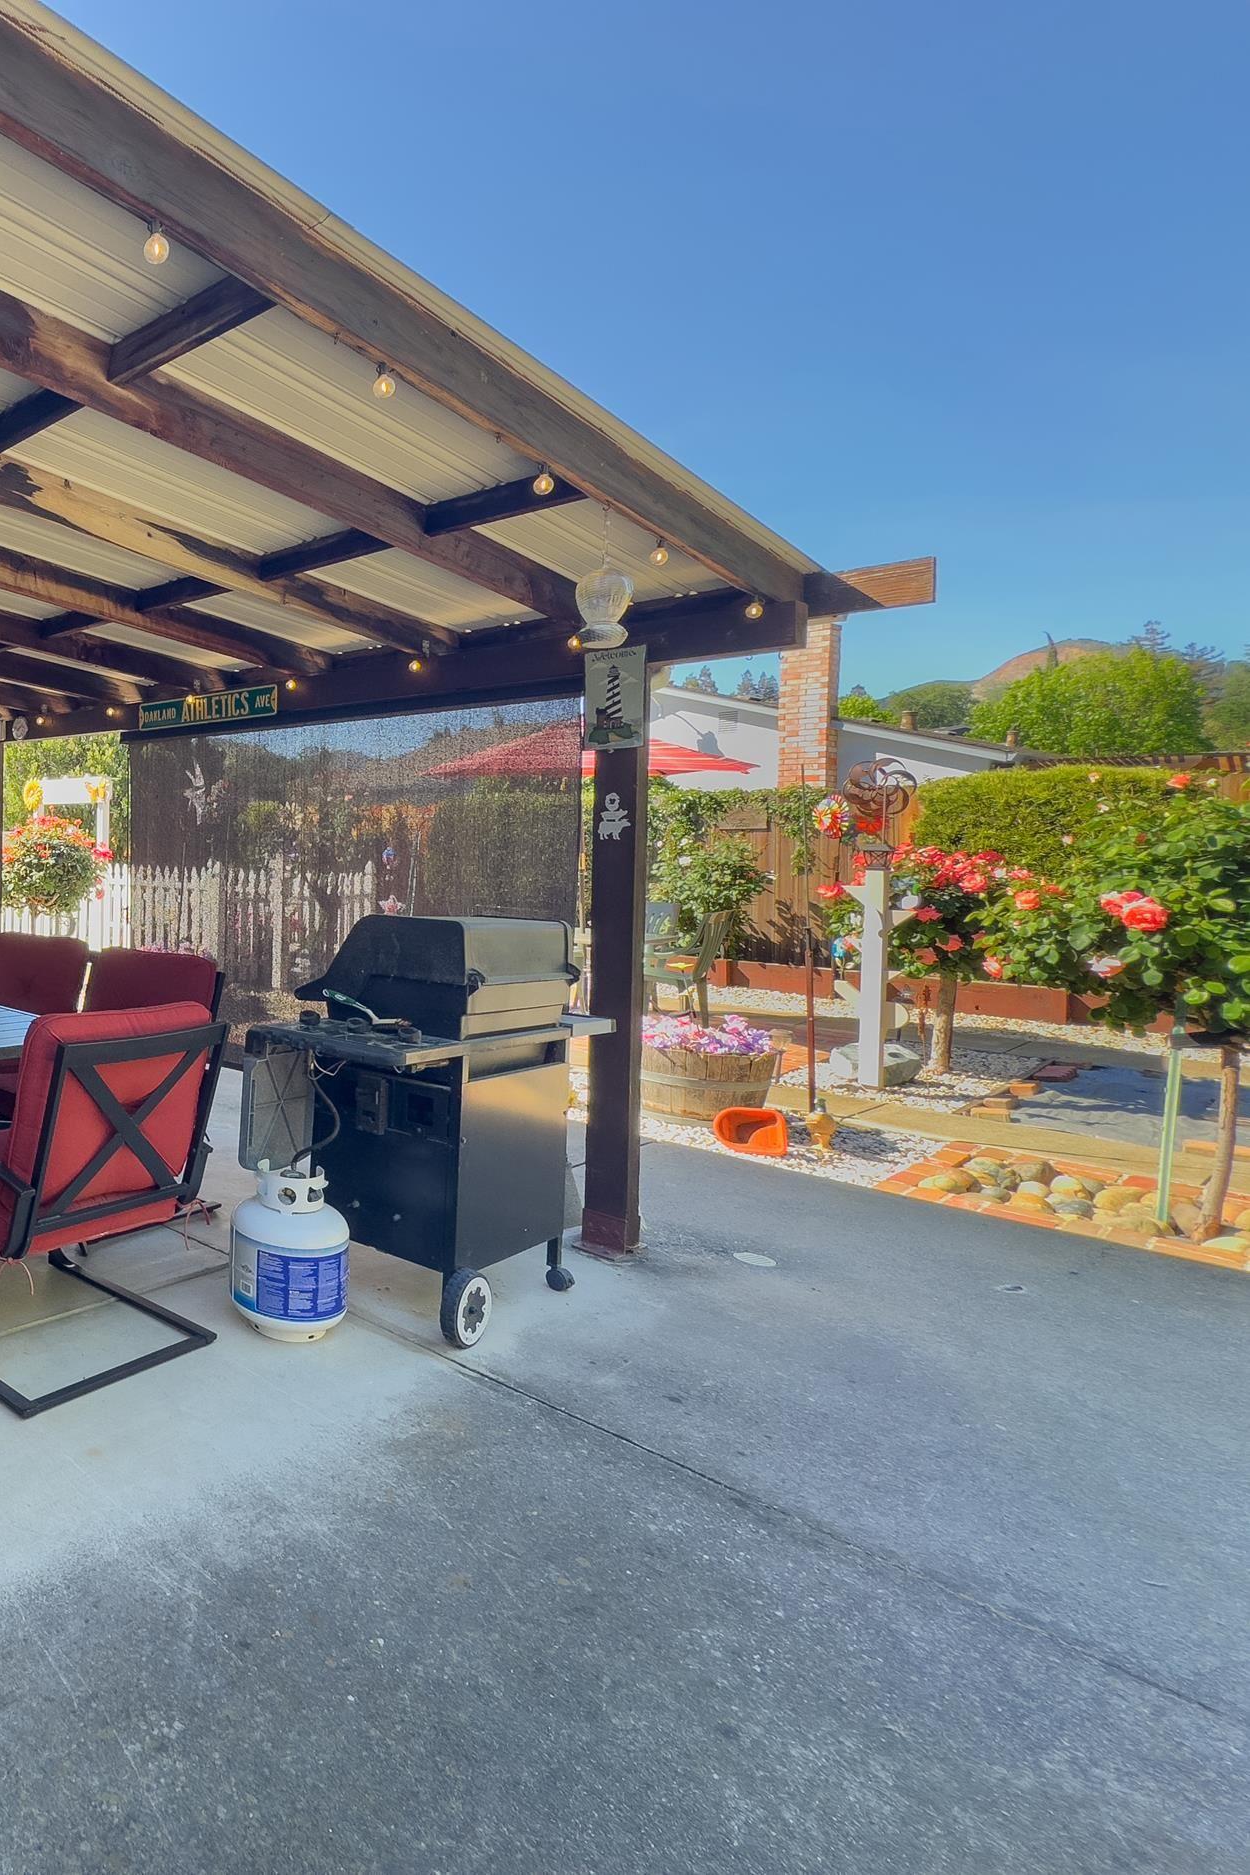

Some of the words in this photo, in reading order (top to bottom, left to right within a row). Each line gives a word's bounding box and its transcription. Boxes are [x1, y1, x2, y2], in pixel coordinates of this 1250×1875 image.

[144, 707, 177, 723] OAKLAND
[181, 691, 249, 722] ATHLETICS
[254, 693, 271, 709] AVE
